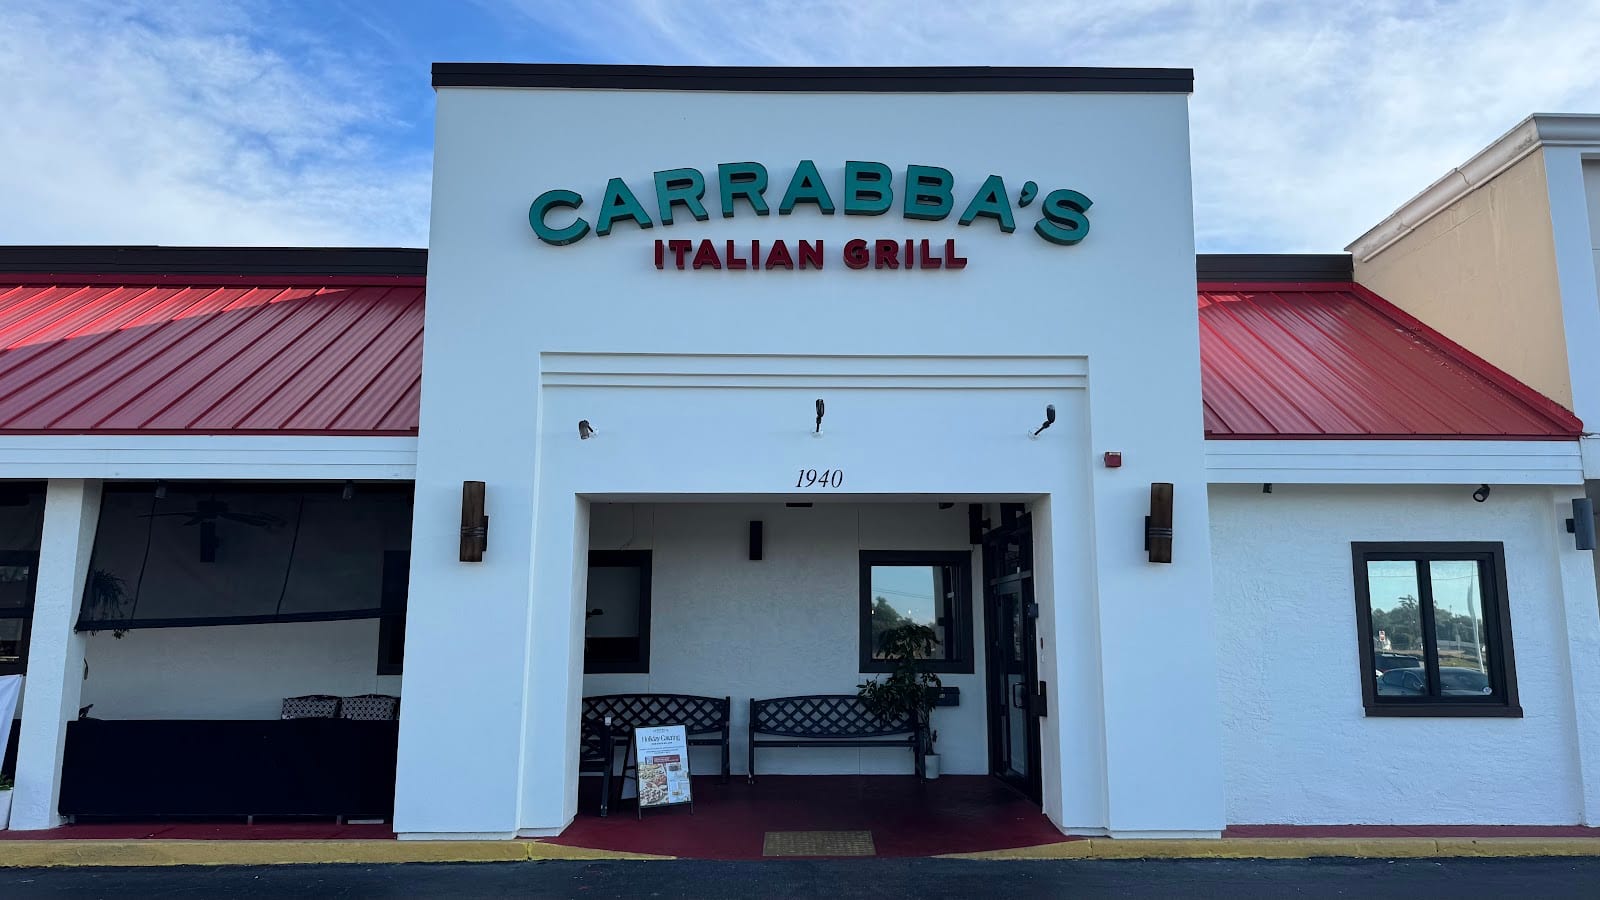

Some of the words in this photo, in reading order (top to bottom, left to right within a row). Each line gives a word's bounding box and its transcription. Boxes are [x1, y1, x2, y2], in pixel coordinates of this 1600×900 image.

[528, 160, 1094, 246] CARRABBA'S
[654, 239, 824, 270] ITALIAN
[843, 238, 967, 270] GRILL
[795, 469, 843, 488] 1940
